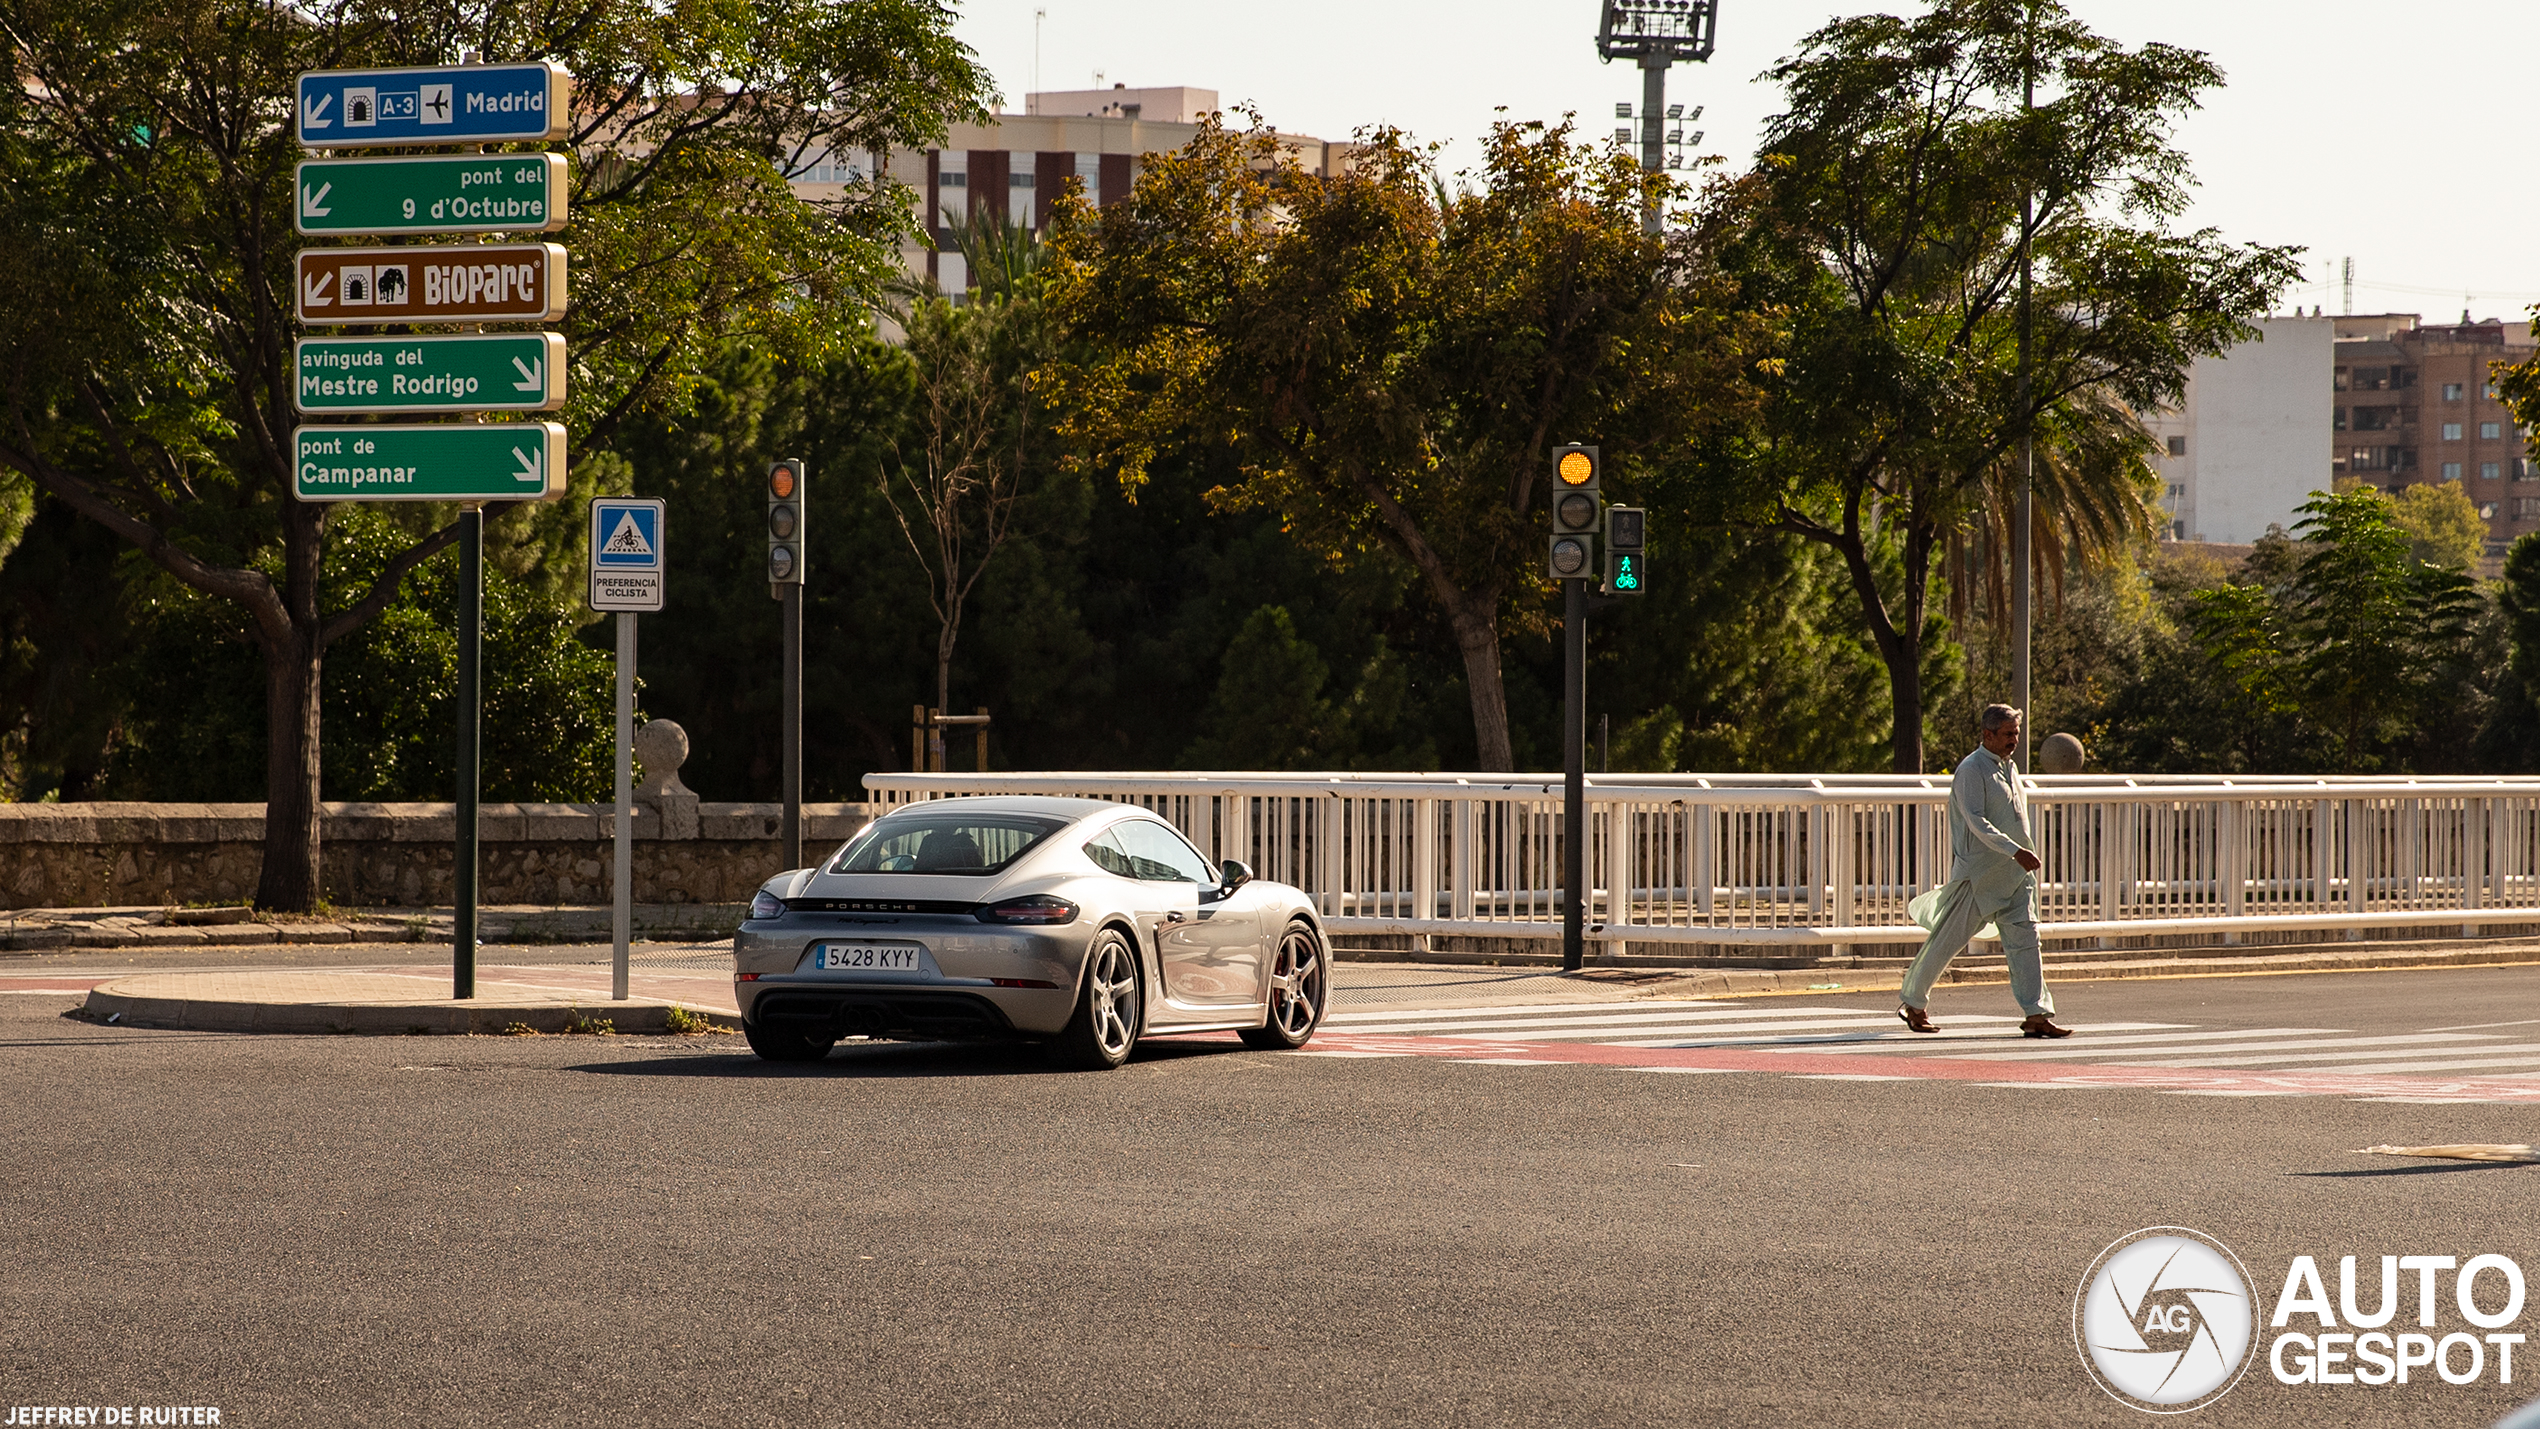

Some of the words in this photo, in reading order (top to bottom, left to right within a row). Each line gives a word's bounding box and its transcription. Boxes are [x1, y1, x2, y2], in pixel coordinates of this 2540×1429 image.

[382, 97, 414, 115] A-3
[466, 90, 543, 114] Madrid
[461, 168, 502, 189] pont
[514, 166, 543, 184] del
[402, 198, 416, 220] 9
[302, 350, 384, 371] avinguda
[395, 348, 424, 366] del
[302, 375, 379, 397] Mestre
[392, 373, 479, 399] Rodrigo
[301, 439, 342, 459] pont
[353, 438, 375, 455] de
[301, 462, 416, 489] Campanar
[596, 578, 657, 588] PREFERENCIA
[605, 588, 648, 598] CICLISTA
[825, 903, 916, 911] PORSCHE
[829, 948, 874, 967] 5428
[879, 949, 914, 968] KYY
